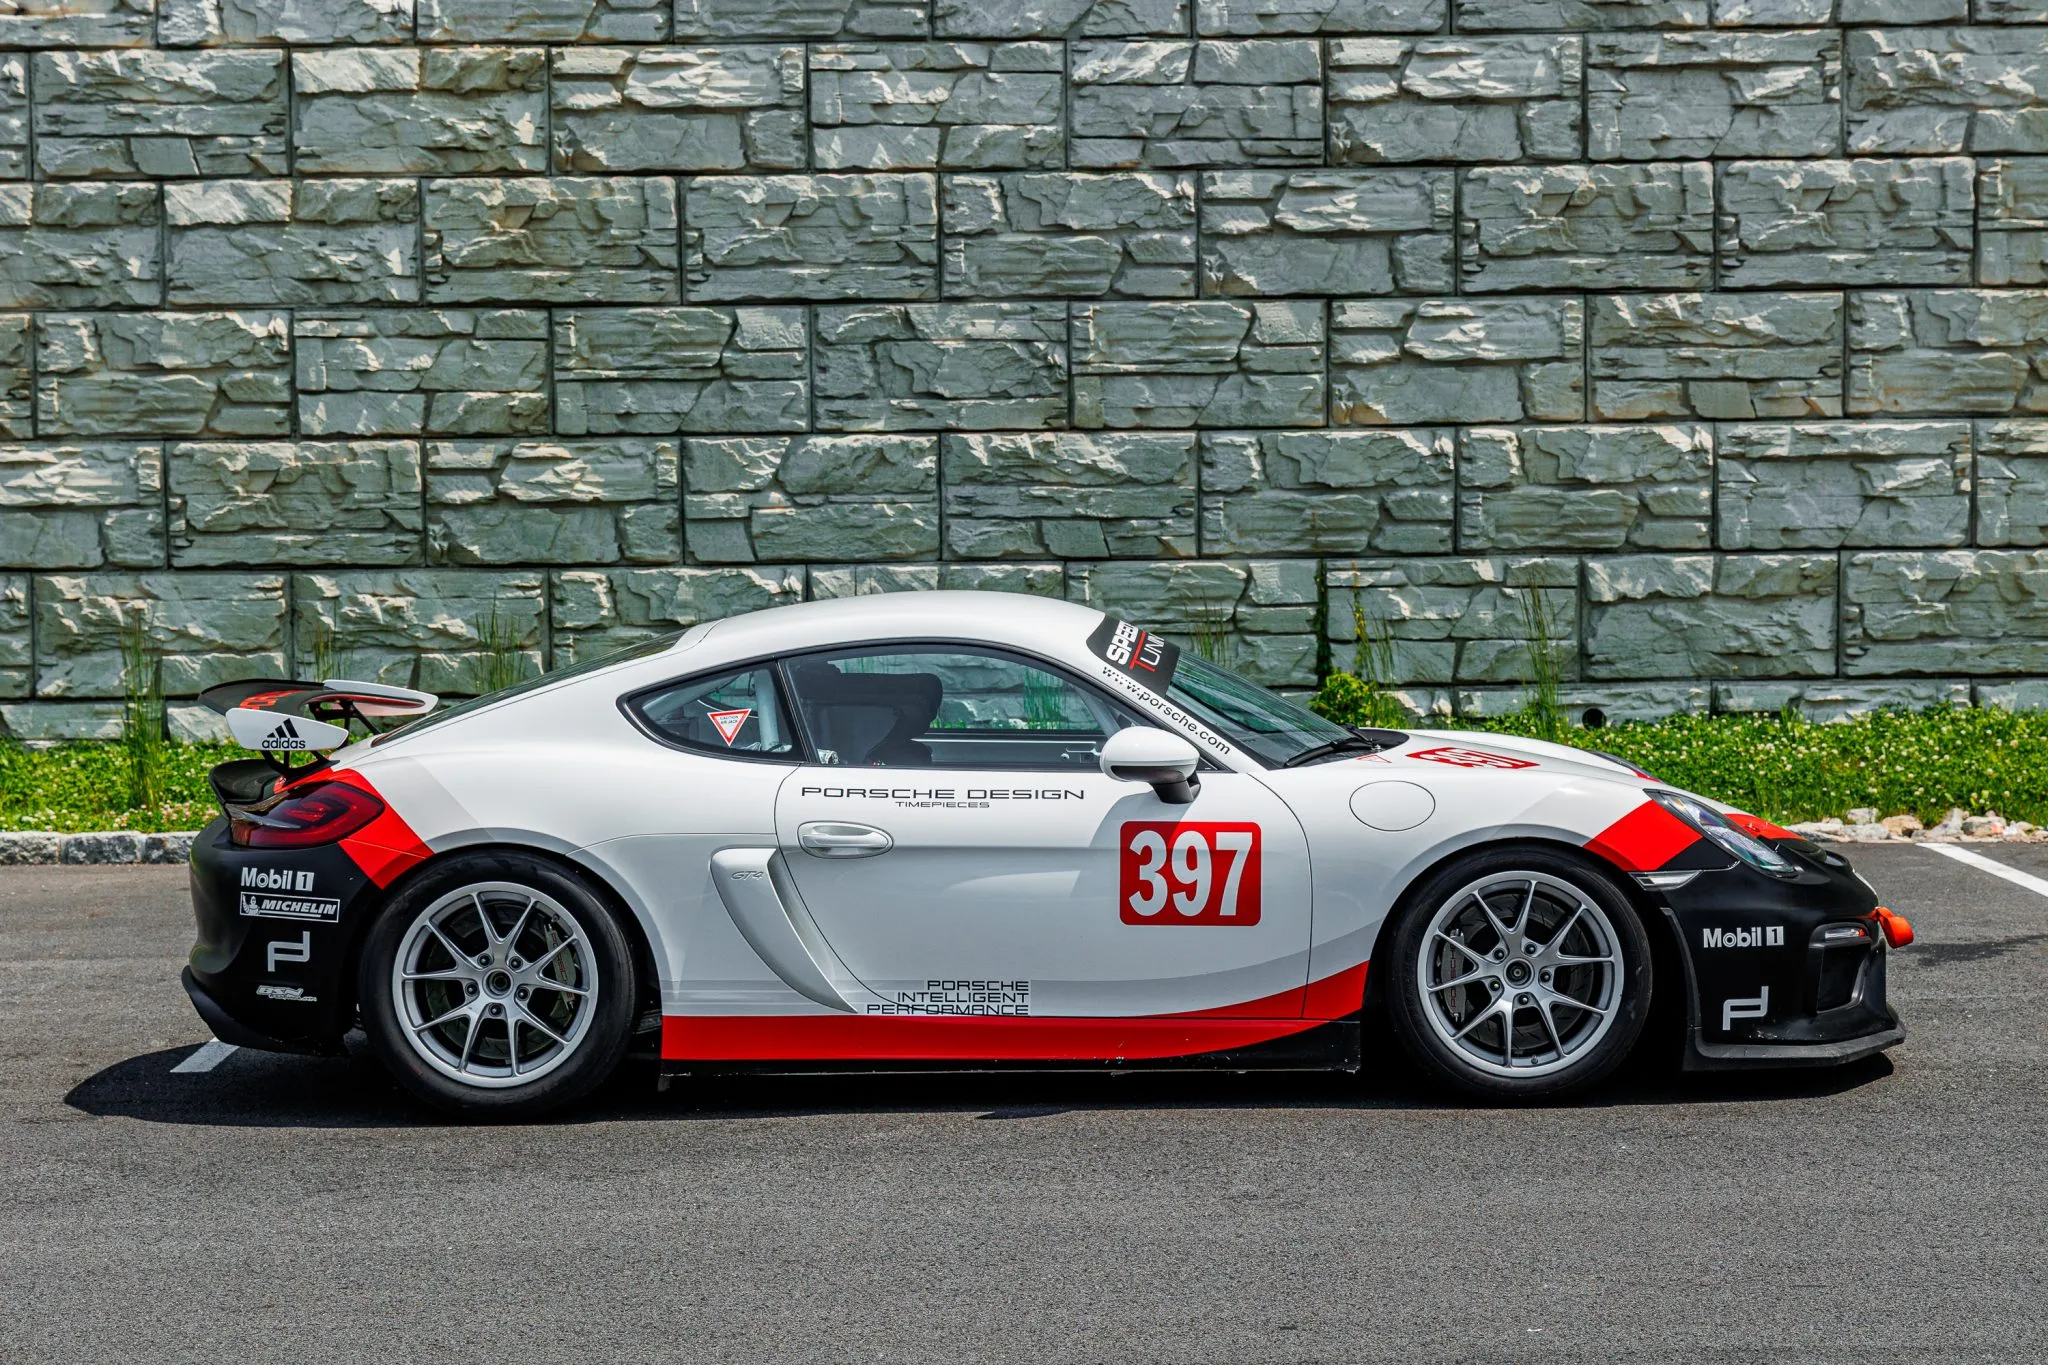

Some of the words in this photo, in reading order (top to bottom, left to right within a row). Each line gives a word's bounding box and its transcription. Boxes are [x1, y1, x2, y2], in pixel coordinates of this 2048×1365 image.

[261, 738, 306, 749] adidas
[801, 787, 955, 799] PORSCHE
[967, 789, 1084, 800] DESIGN
[895, 801, 990, 809] TIMEPIECES
[240, 867, 293, 890] Mobil
[731, 870, 764, 880] GT4
[1128, 829, 1254, 917] 397
[261, 899, 337, 915] MICHELIN
[1703, 926, 1762, 948] Mobil
[927, 980, 1029, 991] PORSCHE
[897, 991, 1029, 1003] INTELLIGENT
[867, 1004, 1029, 1015] PERFORMANCE
